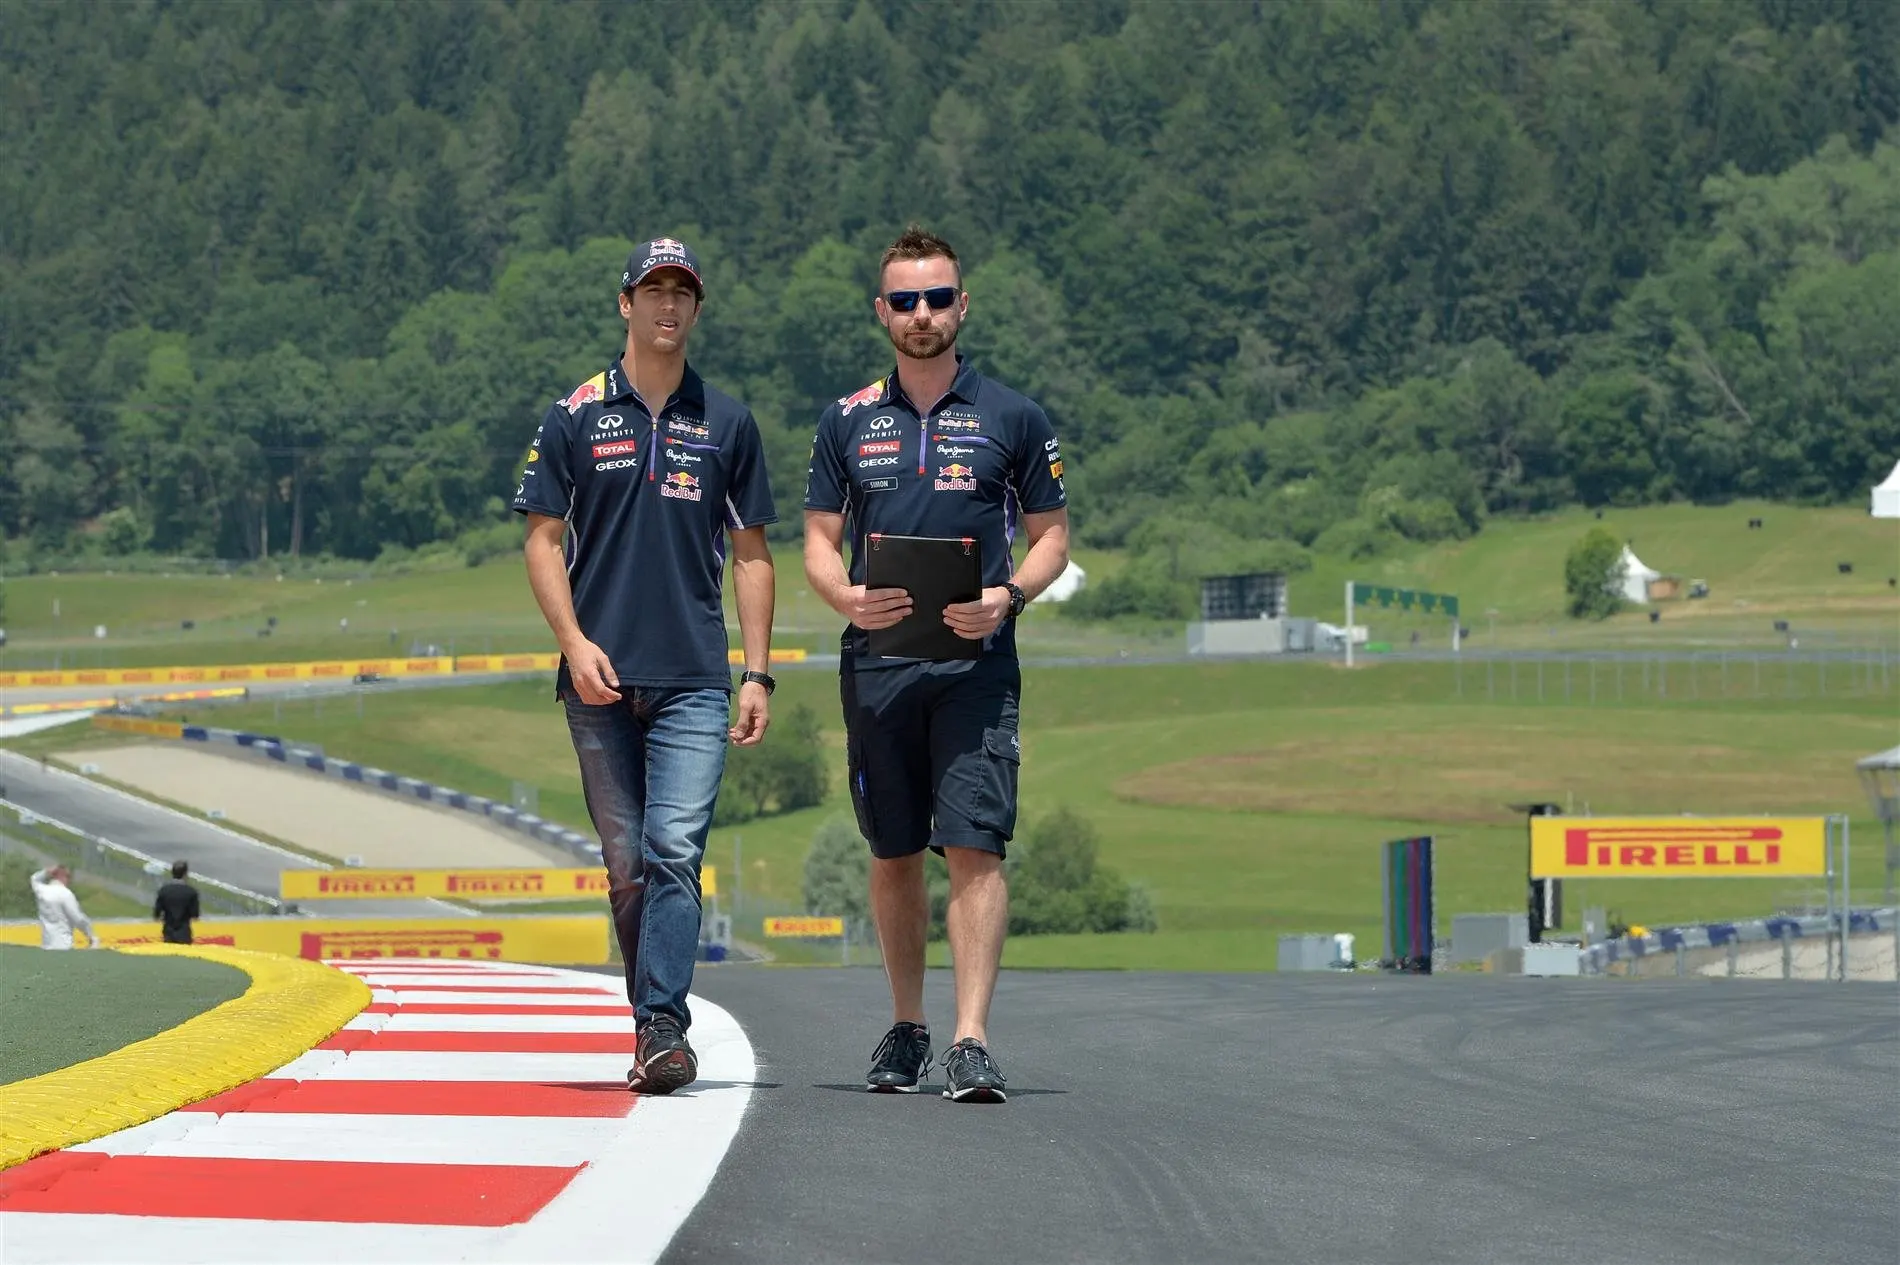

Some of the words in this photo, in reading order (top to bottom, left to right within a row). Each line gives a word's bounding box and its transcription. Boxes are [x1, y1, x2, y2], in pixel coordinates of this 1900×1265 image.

[590, 429, 634, 441] INFINITI
[668, 429, 709, 440] RACING
[861, 430, 902, 440] INFINITI
[595, 444, 633, 455] TOTAL
[862, 444, 898, 453] TOTAL
[595, 458, 637, 471] GEOX
[859, 457, 899, 468] GEOX
[1565, 827, 1783, 866] PIRELLI
[319, 876, 415, 892] PIRELLI
[447, 875, 544, 892] PIRELLI
